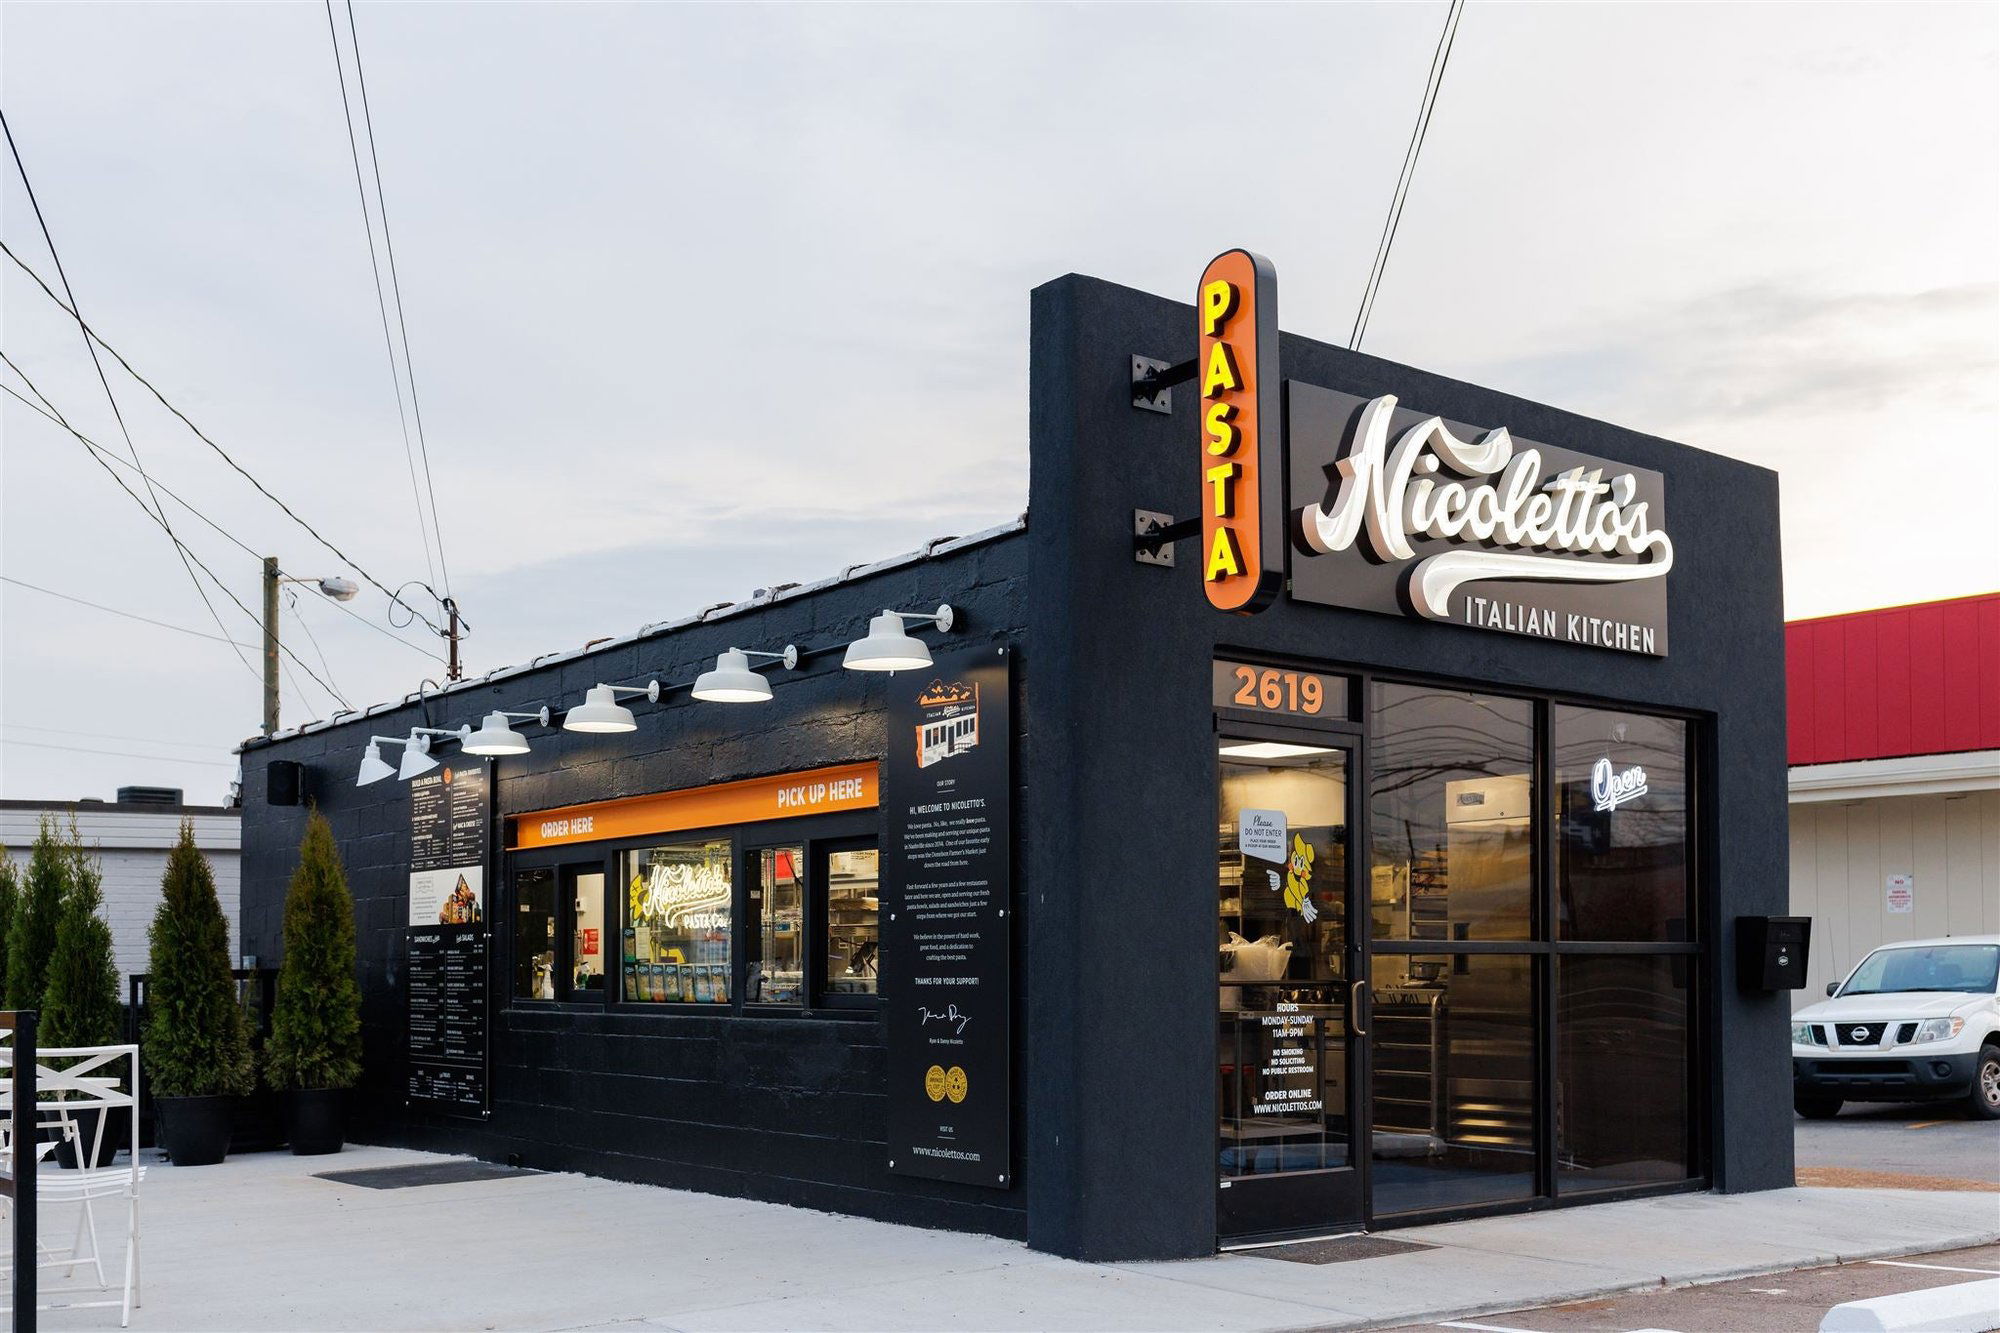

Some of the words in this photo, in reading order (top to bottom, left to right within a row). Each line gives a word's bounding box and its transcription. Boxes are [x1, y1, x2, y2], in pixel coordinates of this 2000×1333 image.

[1203, 279, 1246, 583] PASTA
[1302, 393, 1673, 618] Nicoletto's
[1464, 596, 1556, 638] ITALIAN
[1567, 615, 1655, 654] KITCHEN
[1234, 666, 1324, 715] 2619
[1591, 758, 1647, 811] Open
[778, 787, 805, 808] PICK
[809, 783, 826, 804] UP
[830, 778, 863, 801] HERE
[918, 804, 942, 814] WELCOME
[1253, 815, 1272, 827] Please
[541, 822, 569, 839] ORDER
[571, 817, 594, 835] HERE
[1254, 828, 1264, 836] NOT
[1266, 829, 1282, 837] ENTER
[684, 914, 710, 929] PASTA
[1277, 1003, 1299, 1012] HOURS
[1262, 1016, 1314, 1026] MONDAY-SUNDAY
[1272, 1028, 1303, 1038] 11AM-9PM
[1279, 1057, 1305, 1065] SOLICITING
[1271, 1067, 1287, 1075] PUBLIC
[1288, 1066, 1314, 1074] RESTROOM
[1265, 1091, 1287, 1100] ORDER
[1288, 1089, 1312, 1099] ONLINE
[1254, 1101, 1322, 1114] WWW.NICOLETTOS.COM
[912, 1146, 981, 1162] www.nicolettos.com
